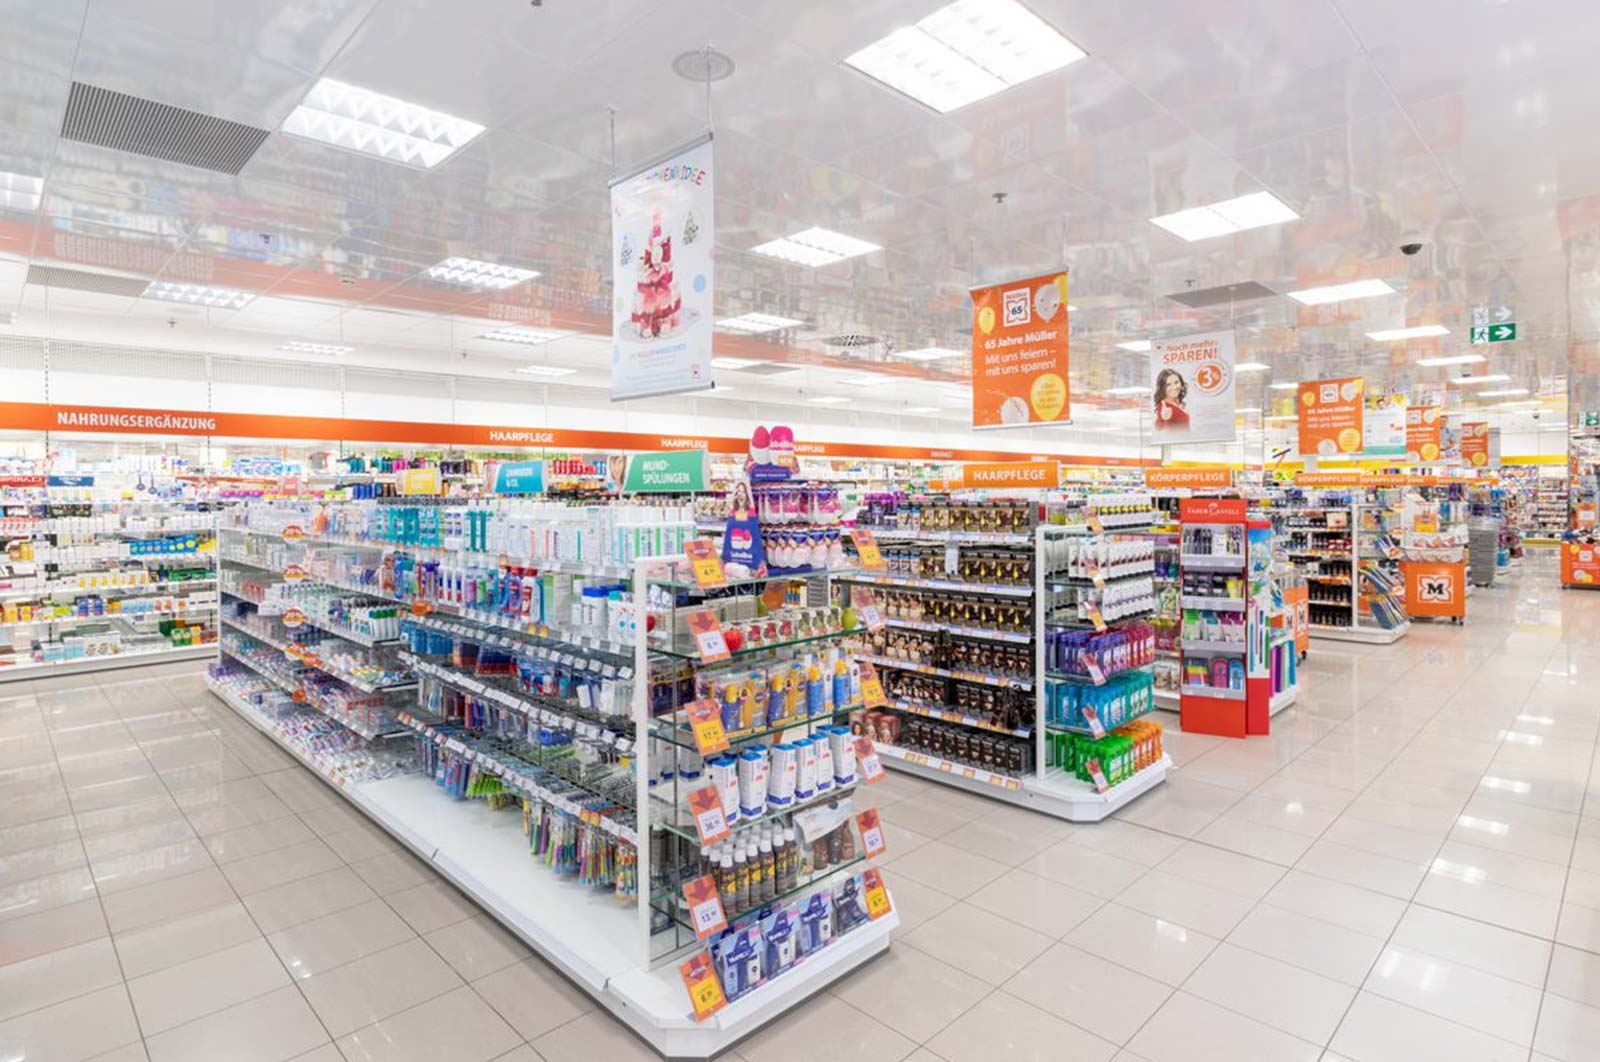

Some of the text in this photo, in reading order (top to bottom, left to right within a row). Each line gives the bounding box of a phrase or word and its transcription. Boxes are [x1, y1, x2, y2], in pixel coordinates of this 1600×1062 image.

[1011, 305, 1023, 315] 65
[984, 330, 1058, 349] 65 Jahre Müller
[985, 353, 1000, 364] Mit
[1001, 352, 1018, 361] uns
[1020, 348, 1048, 359] feiern
[1163, 347, 1217, 363] SPAREN!
[985, 358, 1056, 377] mit uns sparen!
[57, 411, 216, 430] NAHRUNGSERGÄNZUNG
[489, 431, 554, 443] HAARPFLEGE
[661, 439, 709, 449] HAARPFLEGE
[642, 460, 669, 470] MUND-
[642, 471, 690, 484] SPÜLUNGEN
[973, 469, 1047, 481] HAARPFLEGE
[1150, 471, 1226, 483] KÖRPERPFLEGE
[1426, 583, 1444, 595] M
